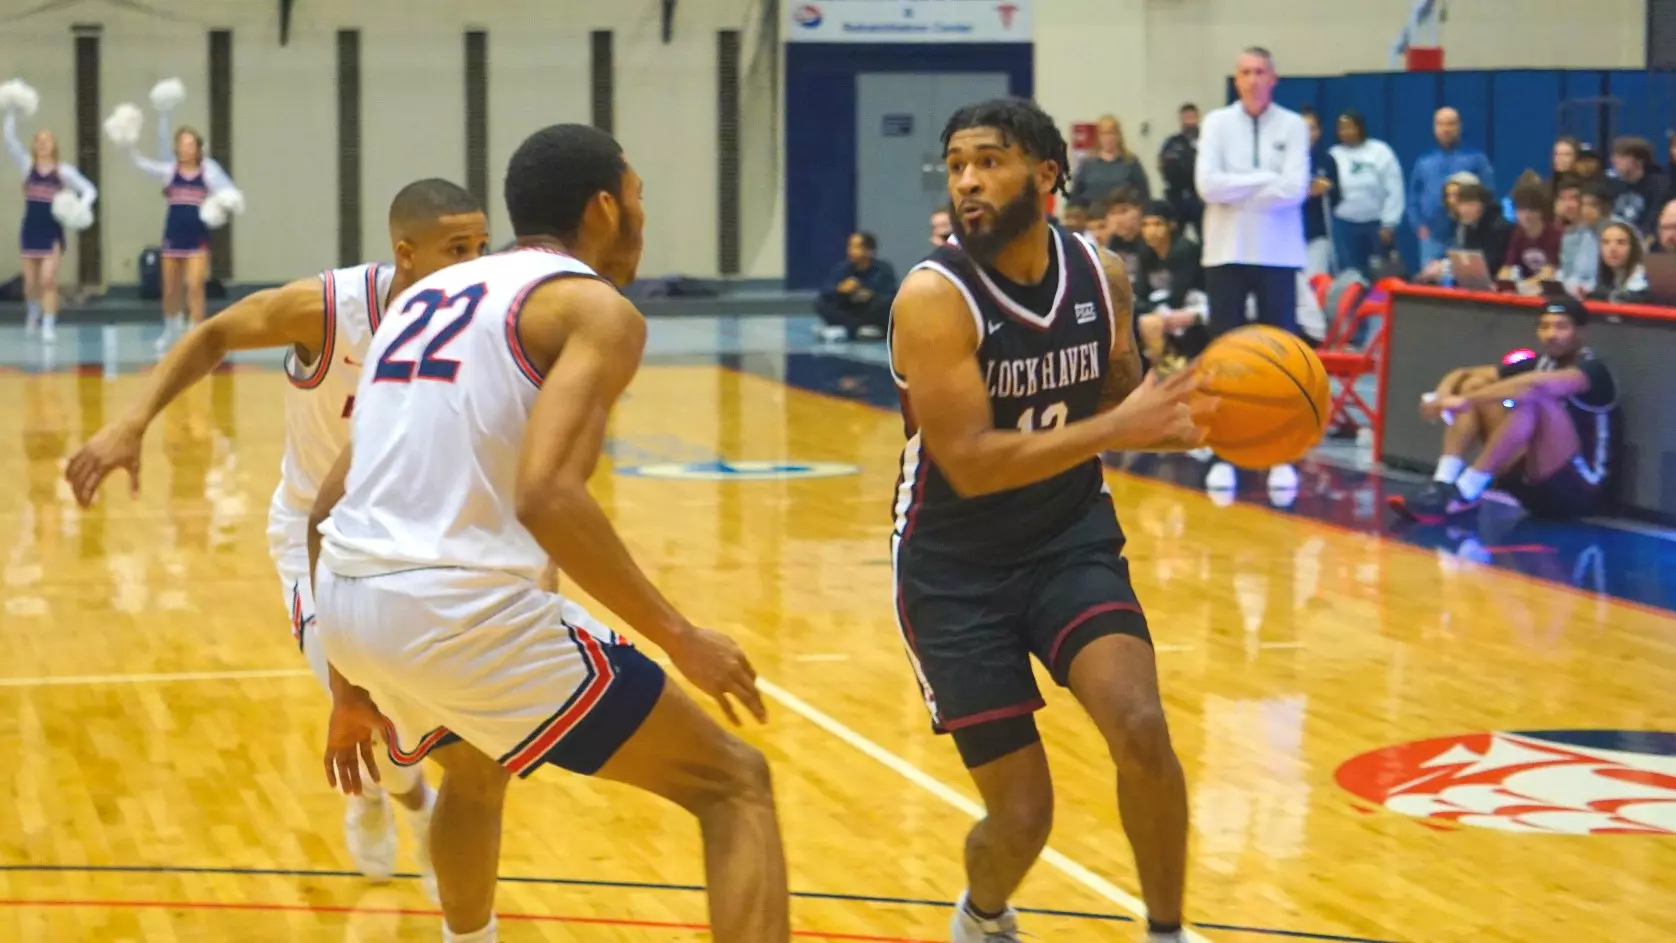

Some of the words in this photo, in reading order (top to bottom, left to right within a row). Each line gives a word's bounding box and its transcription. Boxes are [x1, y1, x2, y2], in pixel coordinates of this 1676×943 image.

[372, 281, 489, 385] 22
[985, 357, 1040, 398] LOCK
[1041, 340, 1100, 391] HAVEN
